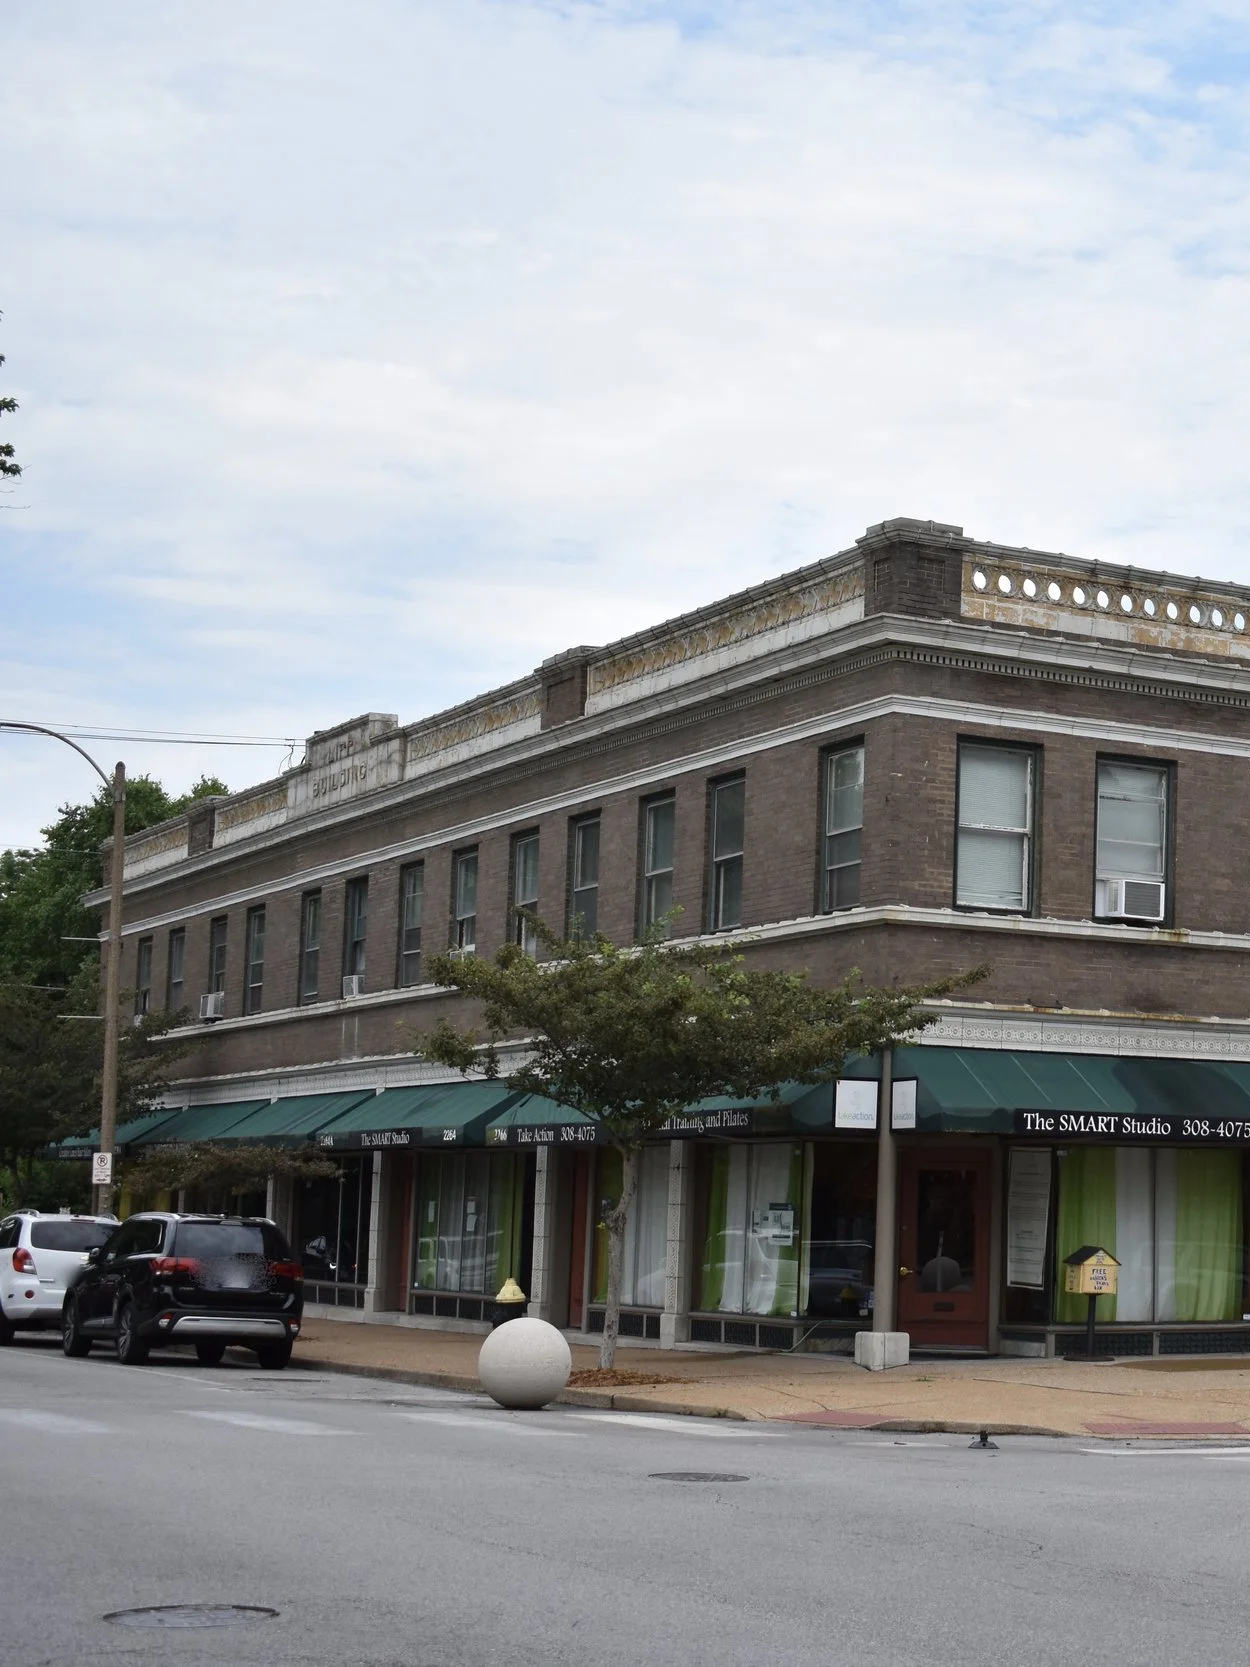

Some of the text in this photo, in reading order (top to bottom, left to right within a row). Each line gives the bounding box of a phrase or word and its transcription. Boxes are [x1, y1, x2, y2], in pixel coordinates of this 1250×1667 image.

[313, 761, 367, 798] BUILDING
[705, 1110, 721, 1128] and
[722, 1109, 749, 1127] Pilates
[1023, 1112, 1055, 1131] The
[1059, 1114, 1118, 1133] SMART
[1122, 1117, 1172, 1135] Studio
[361, 1130, 410, 1146] The SMART Studio
[443, 1129, 457, 1141] 2264
[516, 1126, 596, 1143] Take Action 308-4075
